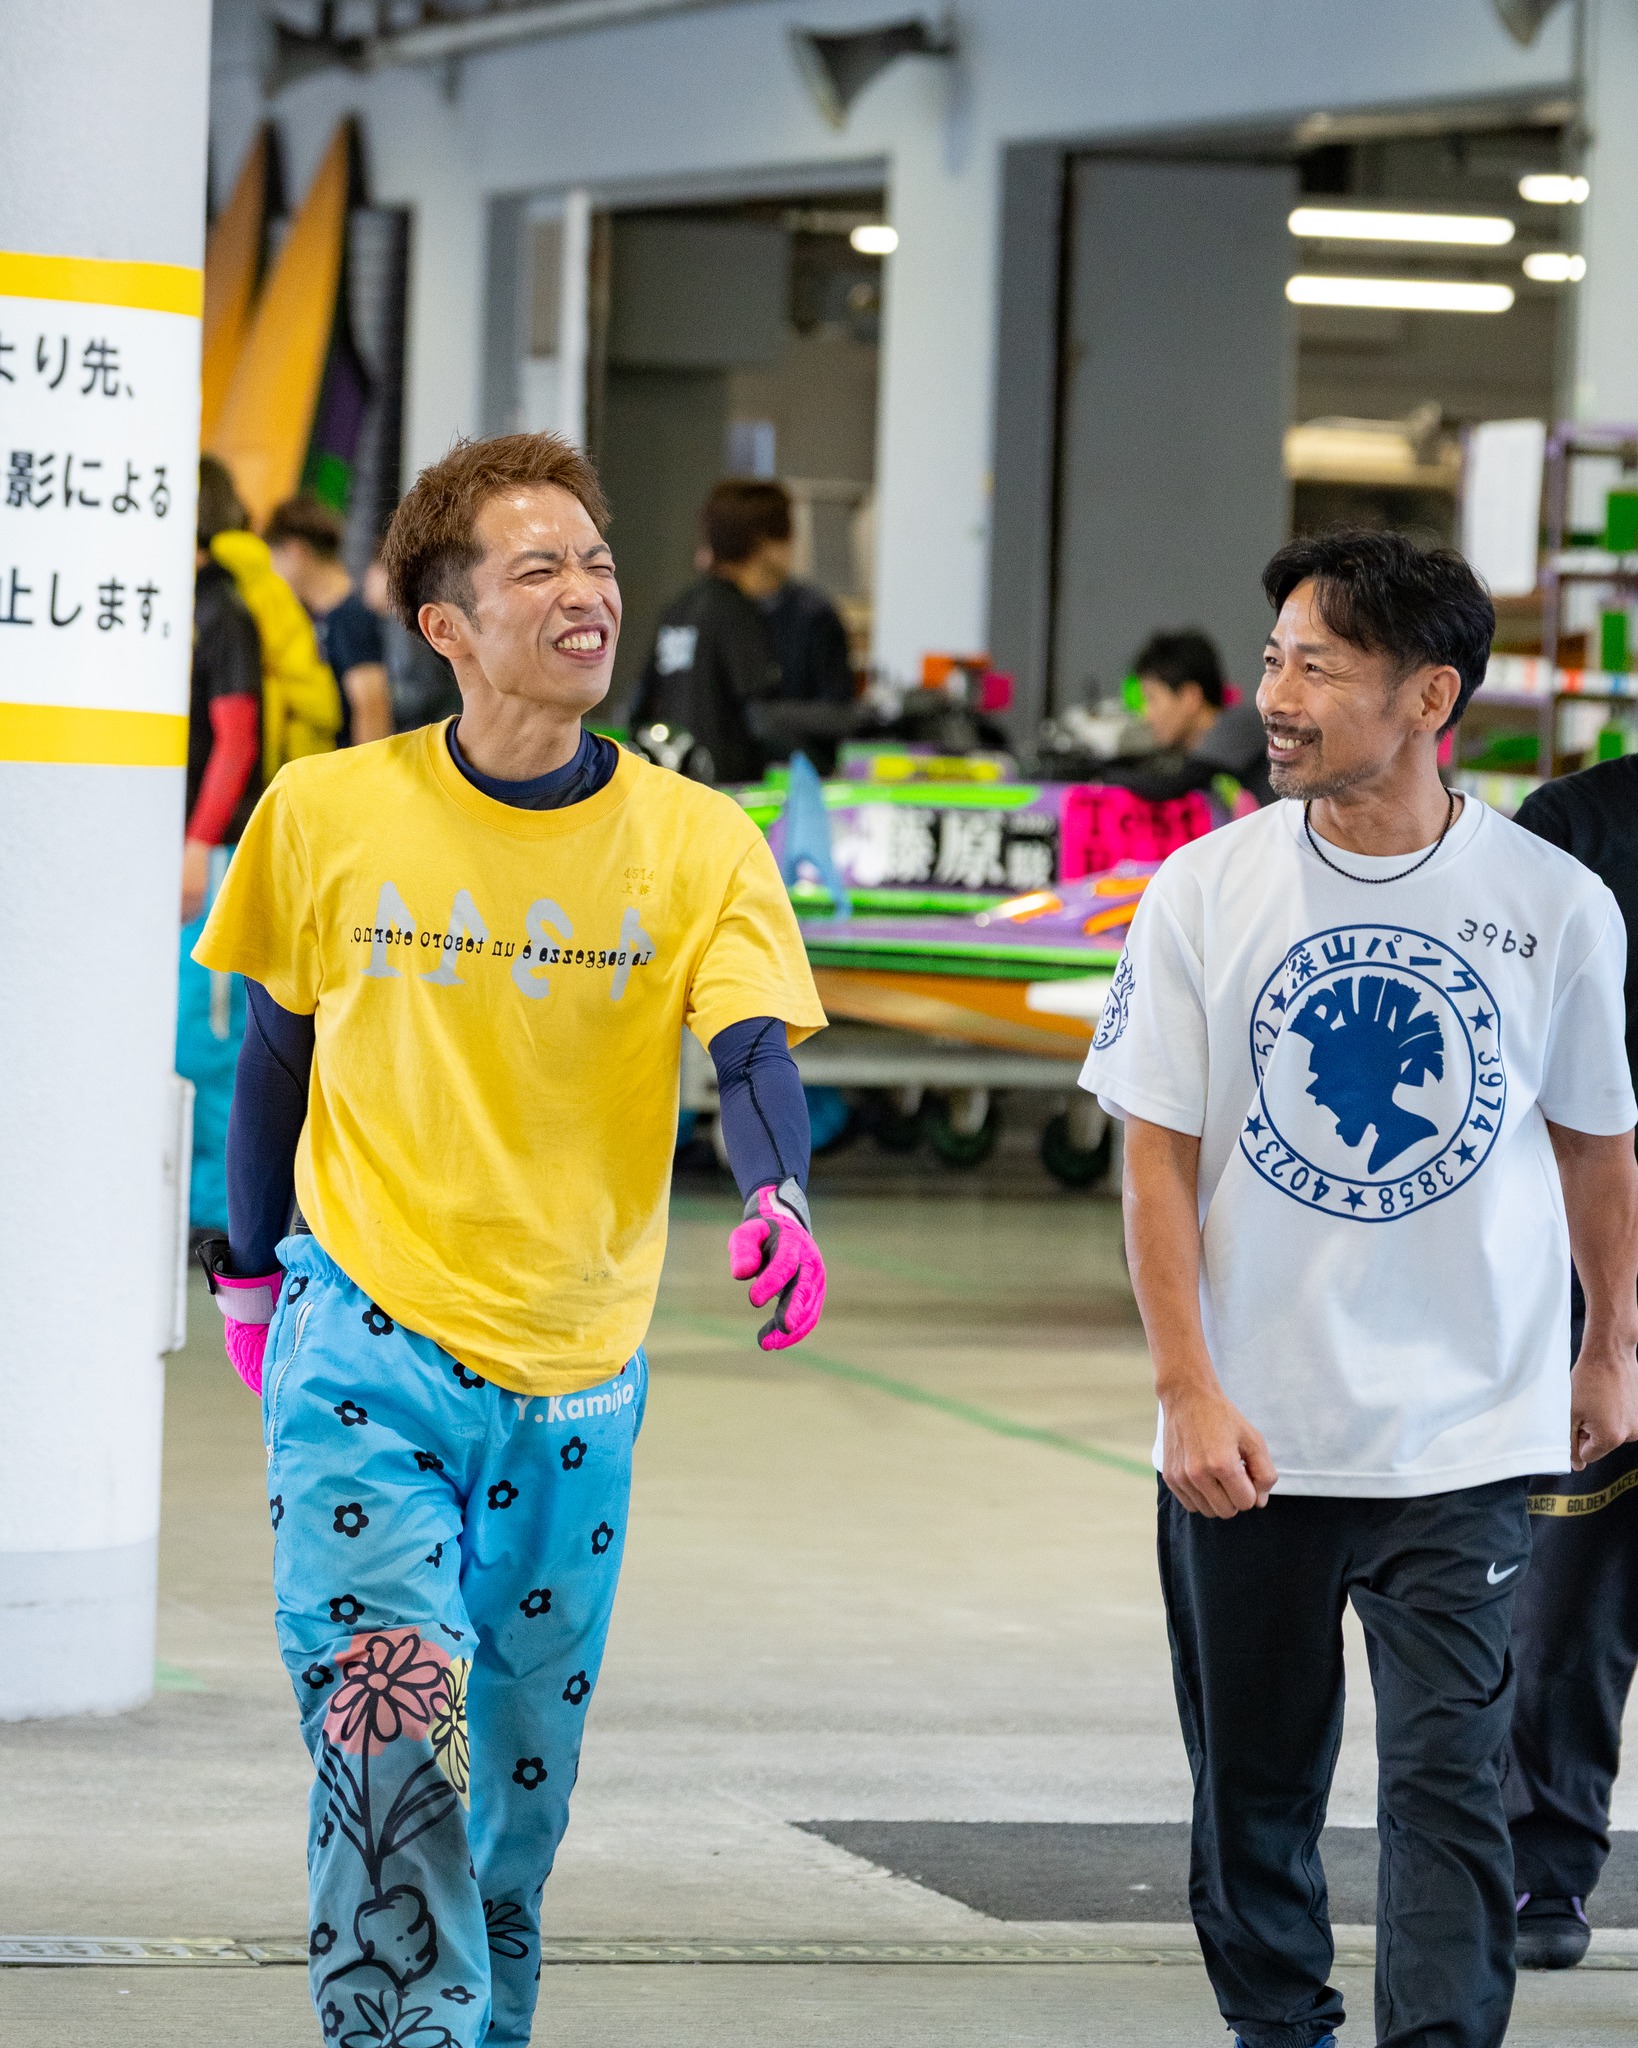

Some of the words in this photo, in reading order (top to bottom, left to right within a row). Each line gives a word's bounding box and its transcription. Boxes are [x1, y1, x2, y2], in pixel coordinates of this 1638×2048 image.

[6, 449, 171, 519] 影による
[1469, 1049, 1503, 1134] 3974
[1256, 1140, 1330, 1202] 4023
[1378, 1160, 1454, 1214] 3858
[513, 1381, 634, 1423] Y.Kamijo
